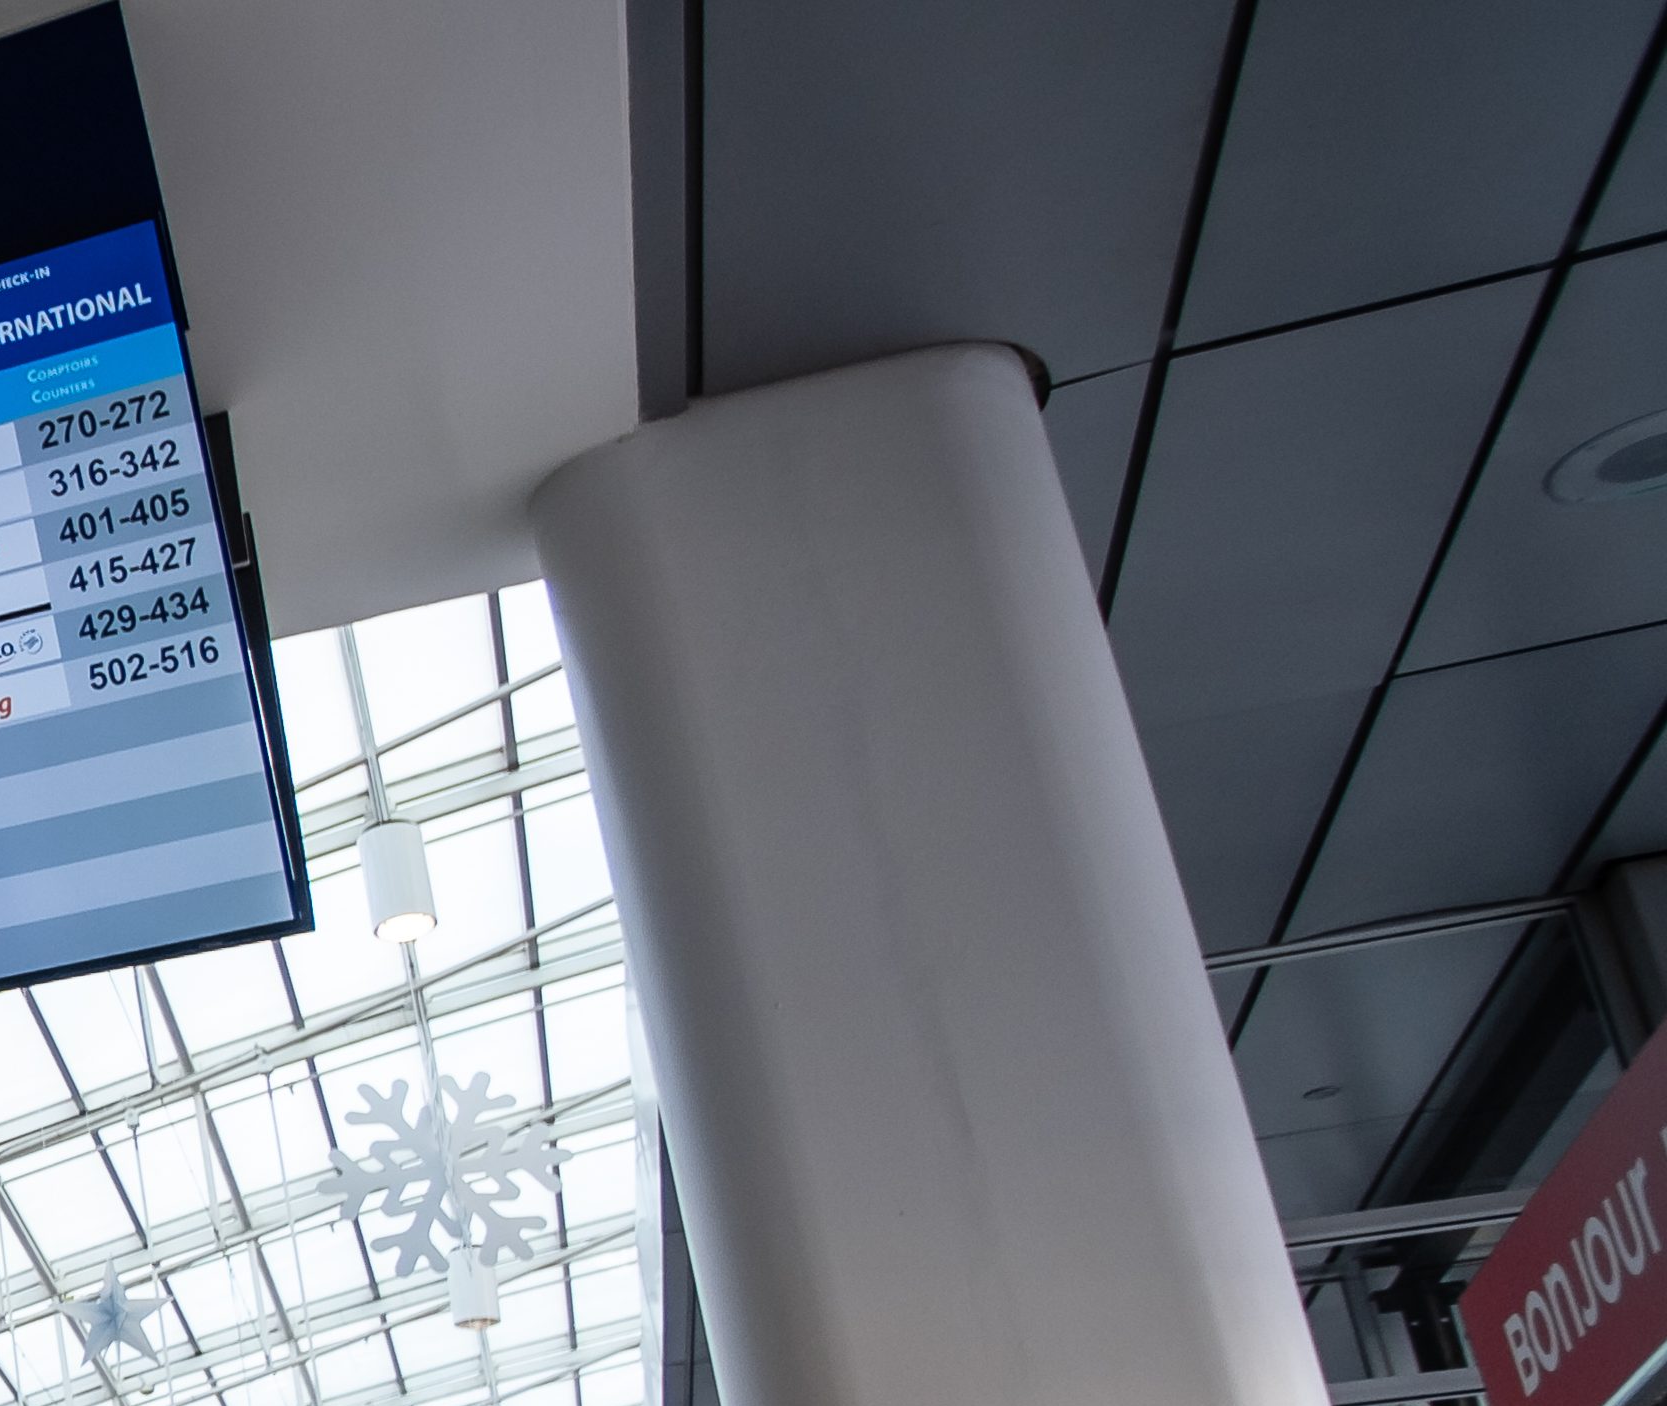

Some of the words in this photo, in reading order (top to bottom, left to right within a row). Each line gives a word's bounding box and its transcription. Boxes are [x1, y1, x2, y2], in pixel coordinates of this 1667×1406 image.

[38, 389, 171, 450] 270-272
[48, 439, 181, 498] 316-342
[59, 487, 191, 545] 401-405
[69, 537, 197, 593] 415-427
[78, 587, 210, 641] 429-434
[88, 635, 220, 690] 502-516
